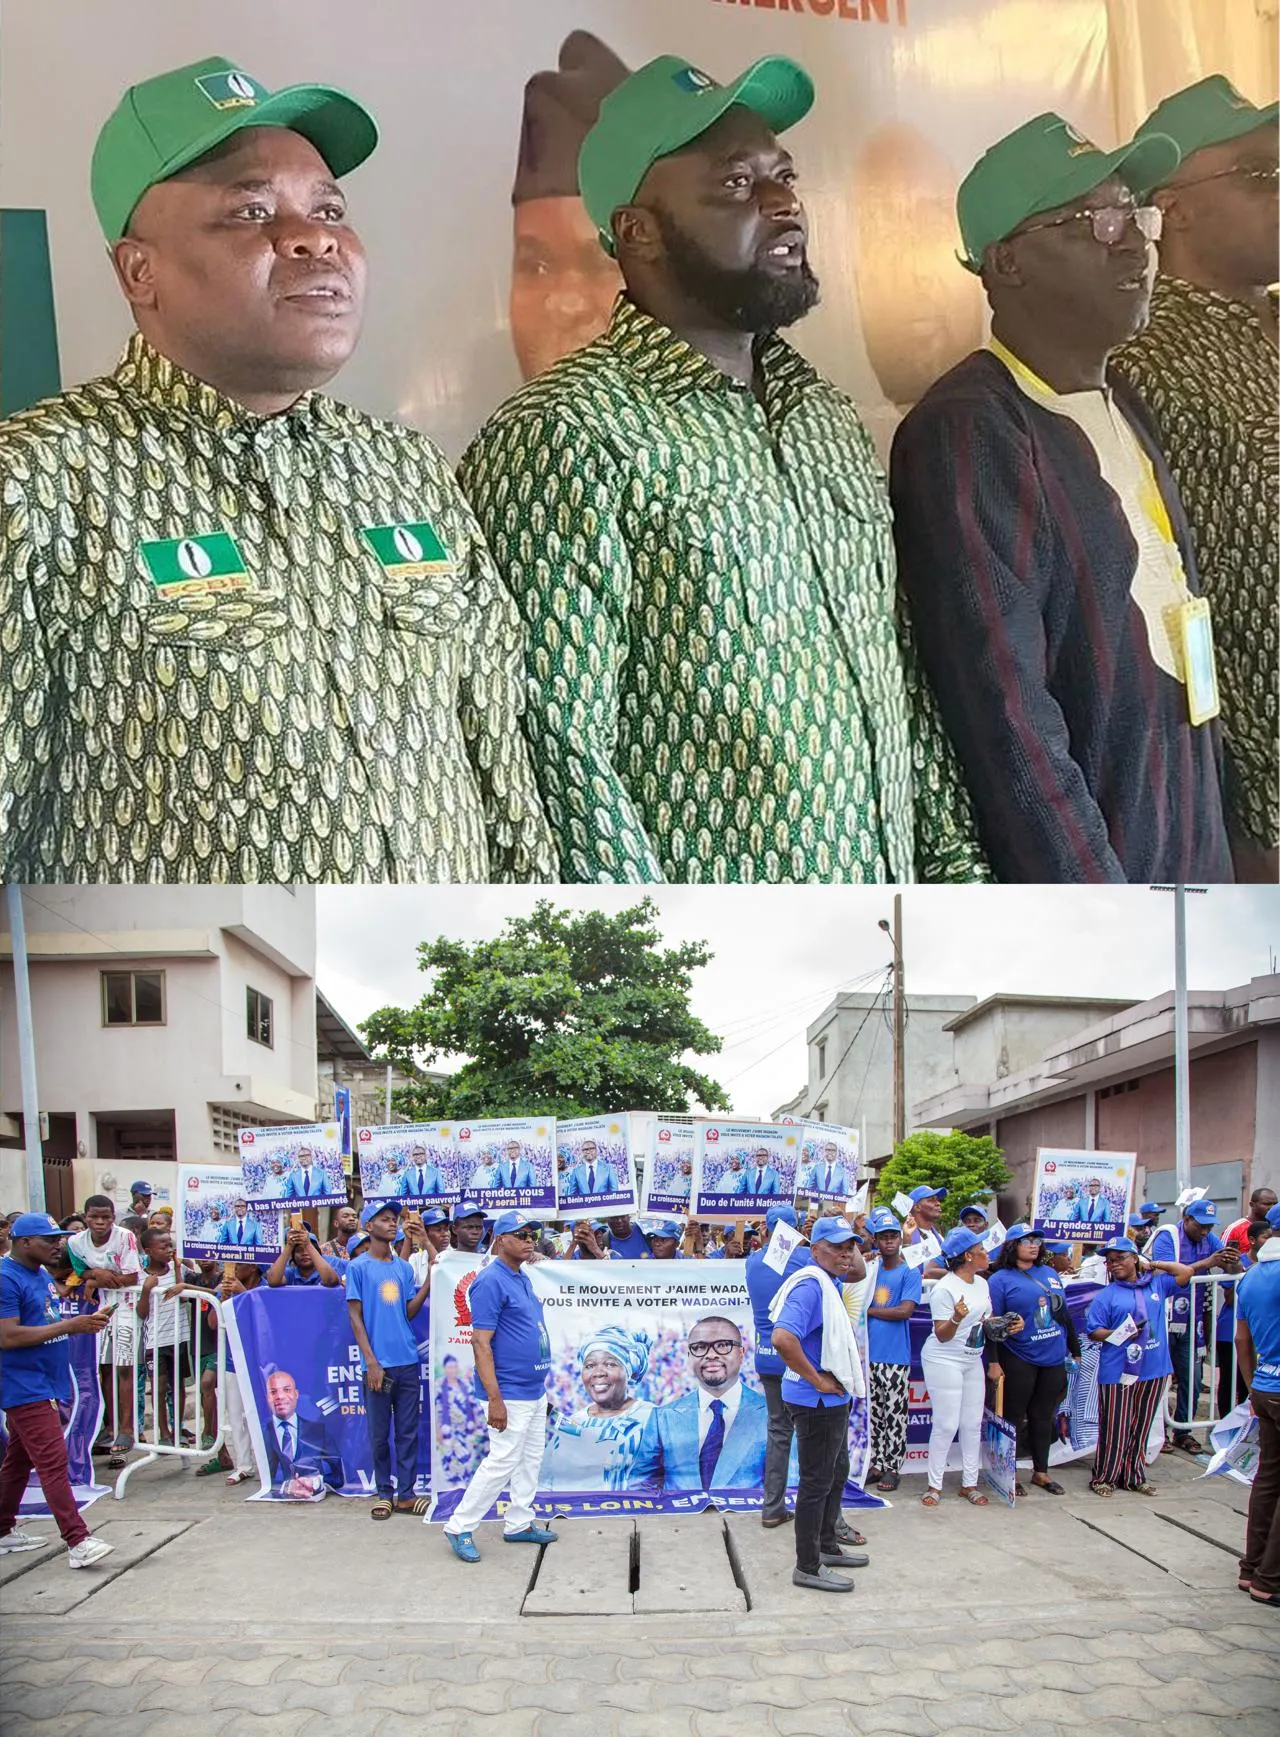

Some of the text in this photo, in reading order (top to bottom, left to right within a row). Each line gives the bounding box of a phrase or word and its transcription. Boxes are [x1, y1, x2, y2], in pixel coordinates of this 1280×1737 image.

[464, 1188, 544, 1198] Au rendez vous
[602, 1192, 631, 1201] confiance
[255, 1202, 269, 1211] bas
[311, 1195, 349, 1208] pauvreté
[425, 1194, 461, 1205] pauvreté
[495, 1198, 517, 1206] serai
[700, 1197, 716, 1207] Duo
[718, 1197, 728, 1207] de
[730, 1197, 754, 1207] l'unité
[1043, 1219, 1116, 1231] Au rendez vous
[1071, 1230, 1091, 1238] serai
[191, 1242, 217, 1250] croissance
[221, 1251, 242, 1260] serai
[560, 1285, 747, 1295] LE MOUVEMENT J'AIME WADA
[577, 1298, 620, 1307] INVITE
[624, 1298, 632, 1307] A
[636, 1298, 678, 1307] VOTER
[682, 1297, 751, 1307] WADAGNI-T
[448, 1337, 472, 1345] J'AIM
[338, 1386, 360, 1403] LE
[341, 1405, 356, 1415] DE
[496, 1501, 573, 1516] PUS
[582, 1499, 664, 1512] LOIN,
